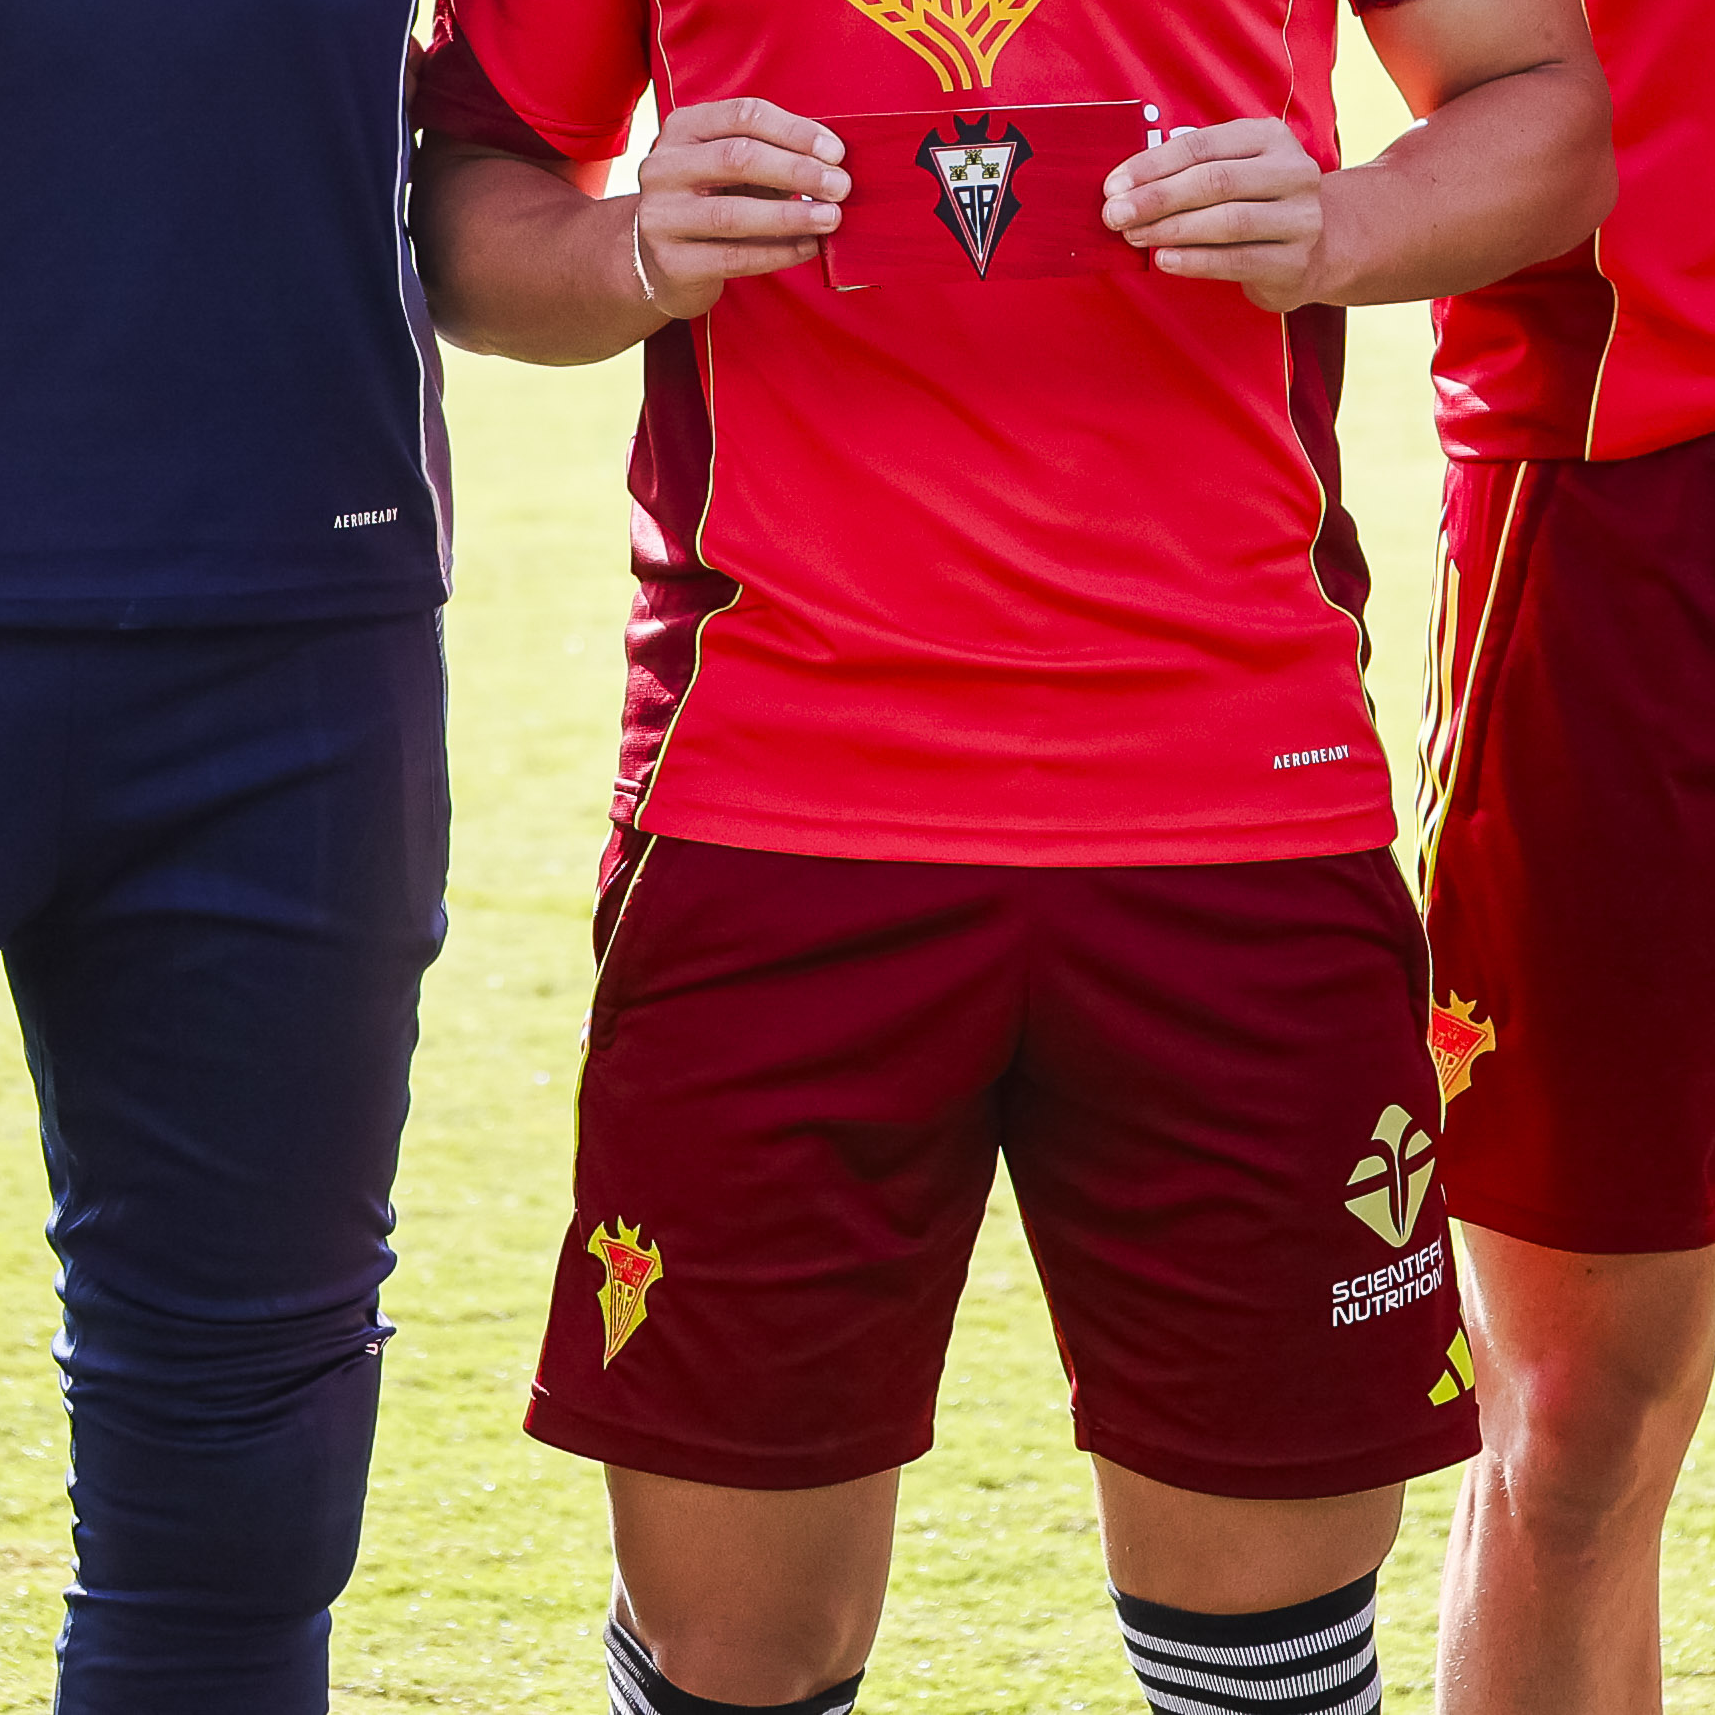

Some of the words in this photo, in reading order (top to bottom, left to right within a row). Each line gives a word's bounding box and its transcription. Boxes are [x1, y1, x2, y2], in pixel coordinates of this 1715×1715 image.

[333, 507, 398, 529] AEROREADY
[1272, 744, 1350, 770] AEROREADY
[1332, 1232, 1443, 1304] SCIENTIFFI
